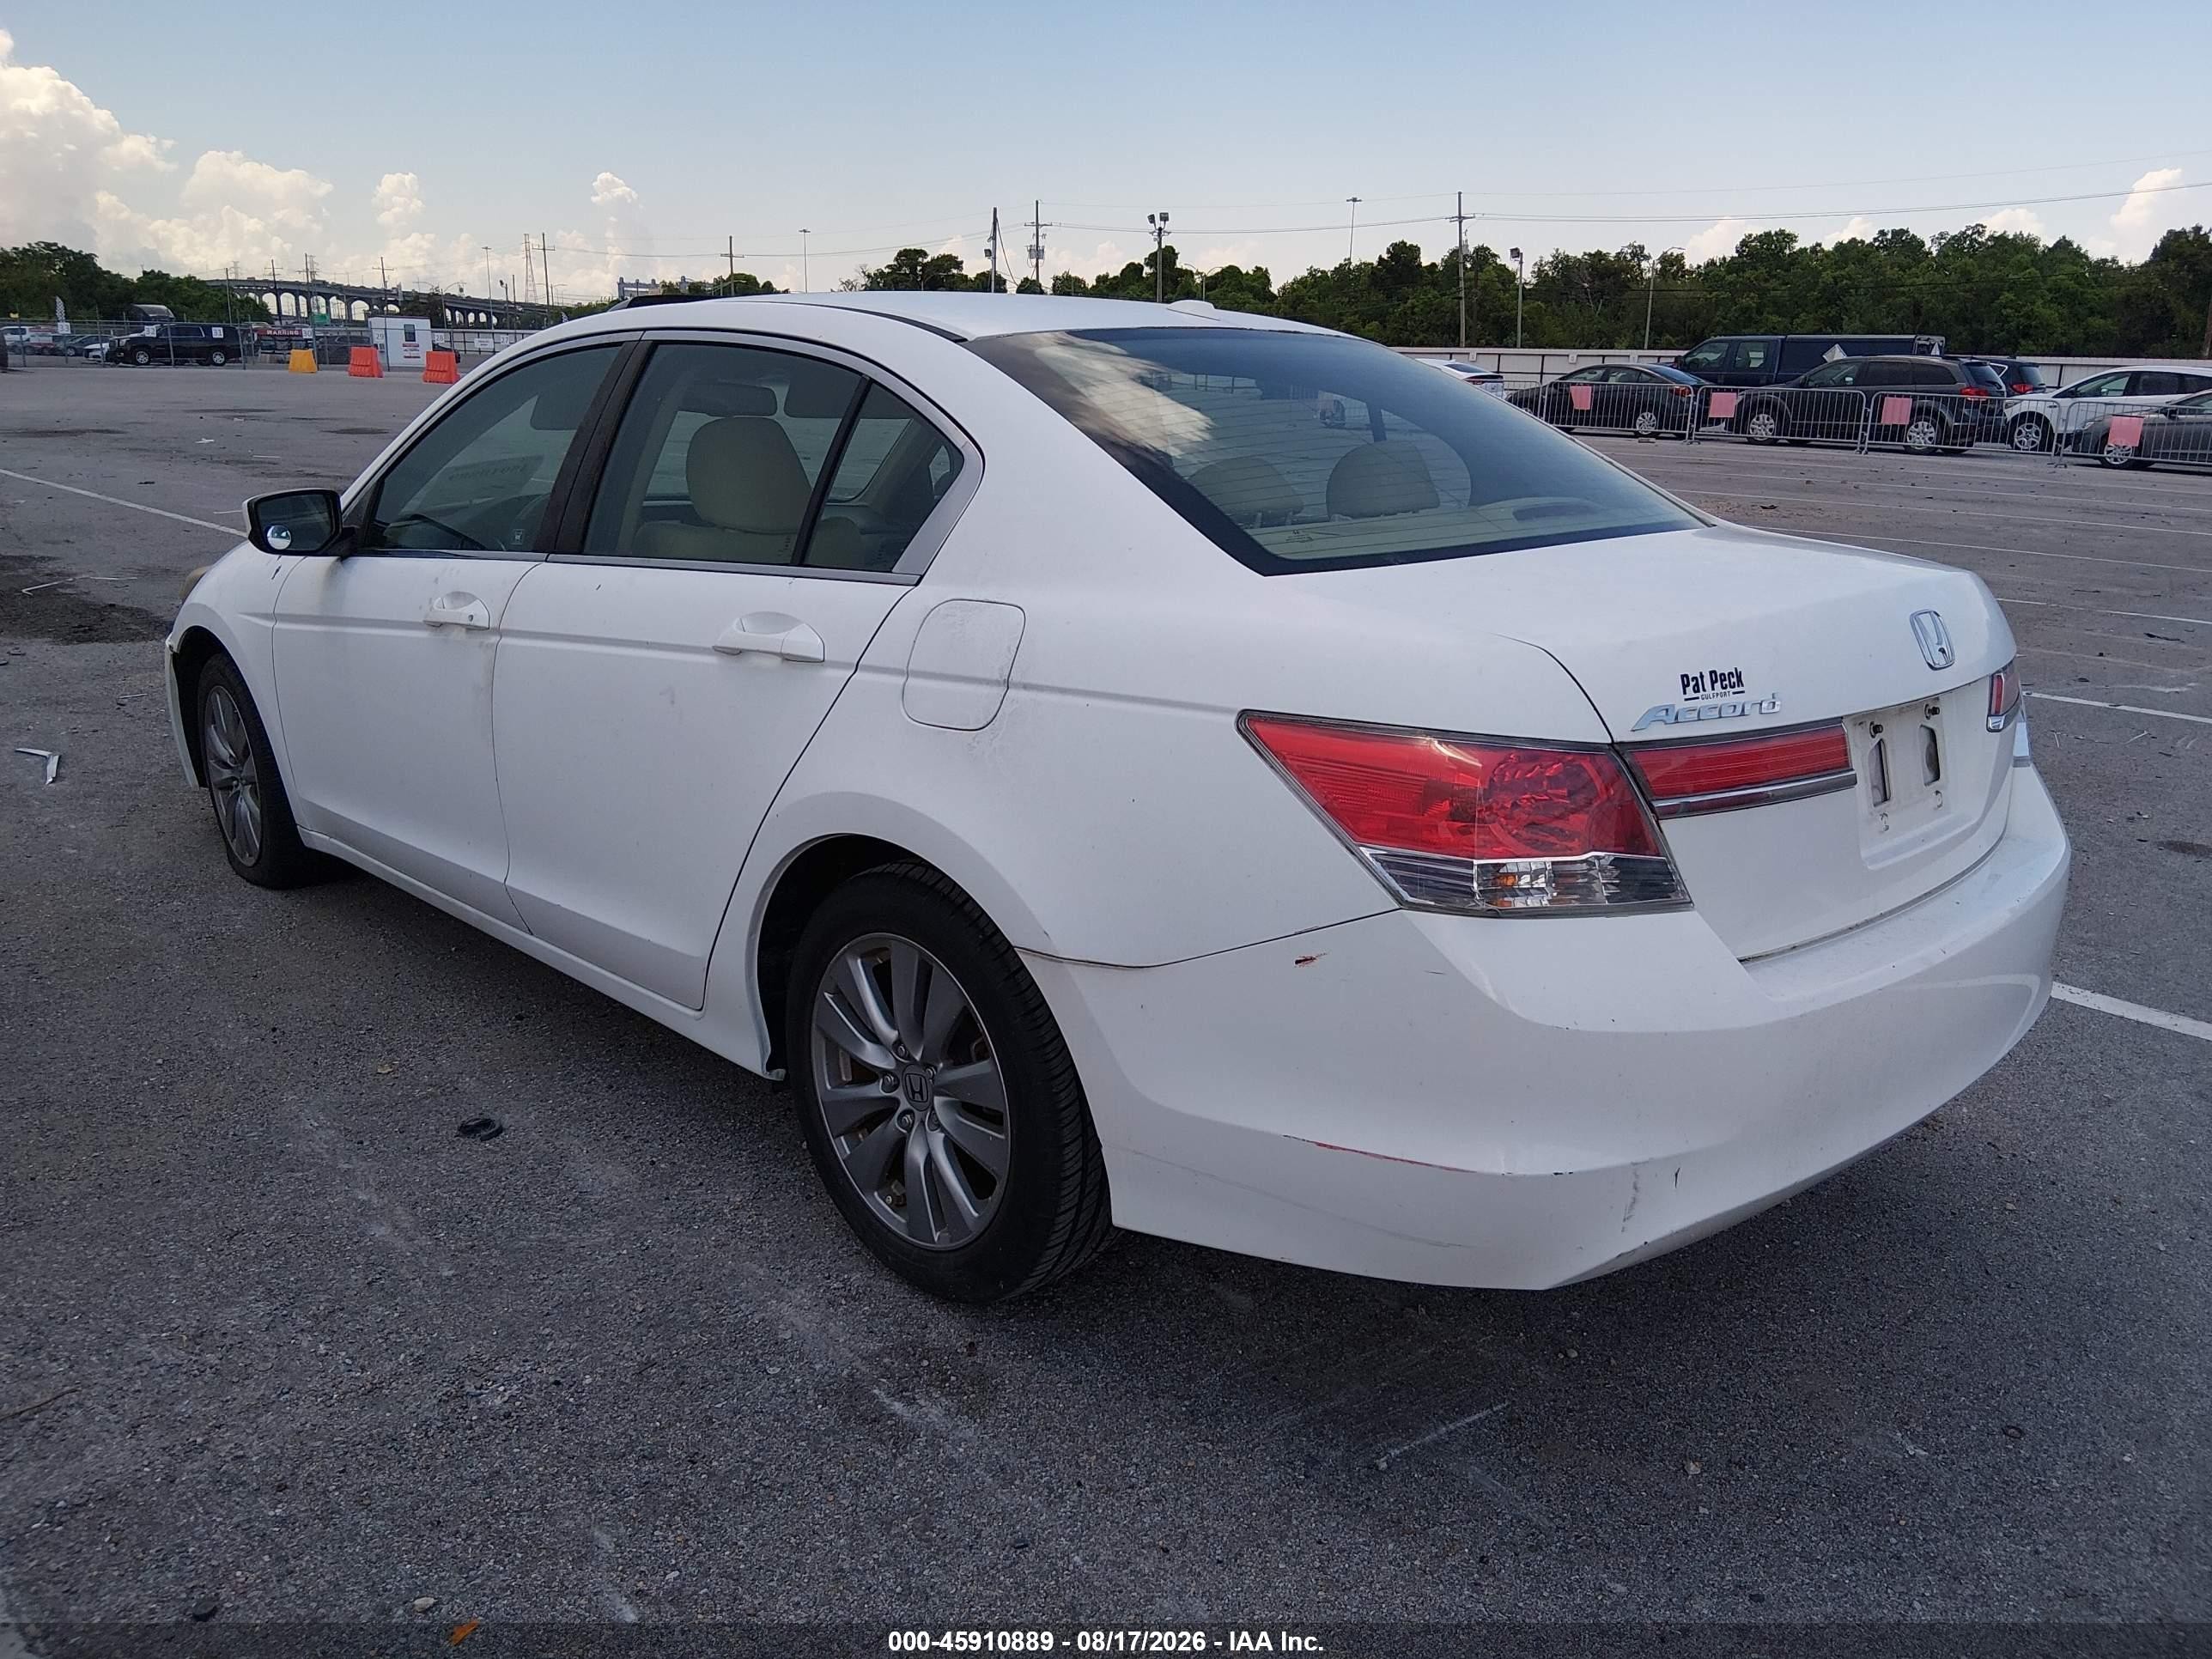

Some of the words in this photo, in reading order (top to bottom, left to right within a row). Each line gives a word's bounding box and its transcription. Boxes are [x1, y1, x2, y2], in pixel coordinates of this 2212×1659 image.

[1680, 671, 1706, 696] Pat
[1709, 666, 1744, 692] Peck
[1700, 690, 1730, 701] GULFPORT
[1630, 692, 1783, 732] Accord
